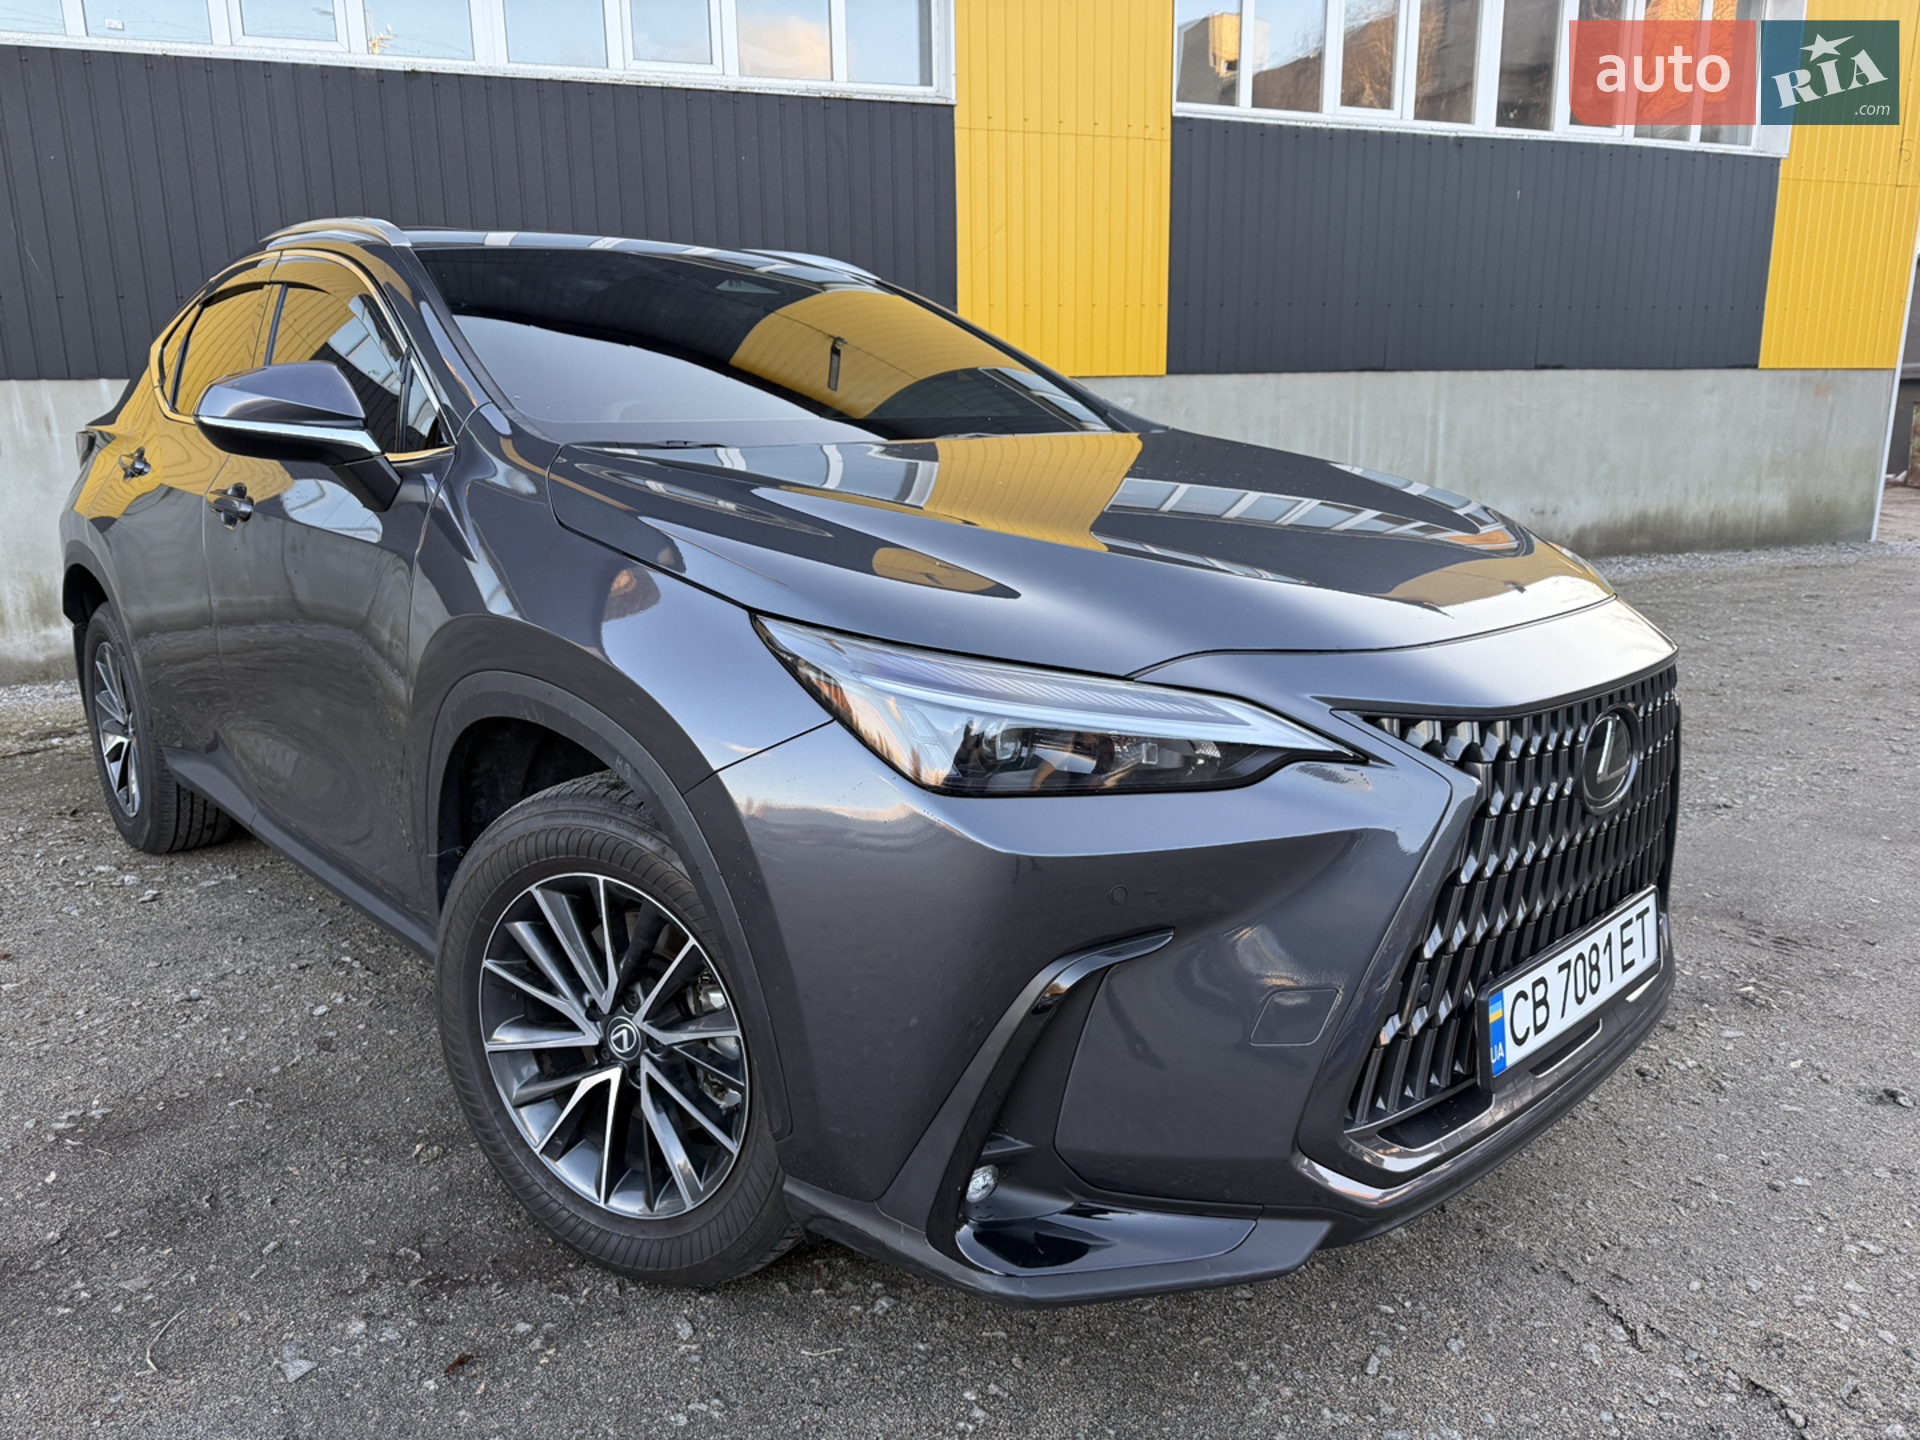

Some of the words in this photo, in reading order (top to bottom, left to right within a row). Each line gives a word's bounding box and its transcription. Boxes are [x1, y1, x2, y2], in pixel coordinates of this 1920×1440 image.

[1509, 975, 1550, 1047] CB
[1557, 931, 1614, 1020] 7081
[1619, 905, 1651, 975] ET
[1490, 1041, 1505, 1064] UA
